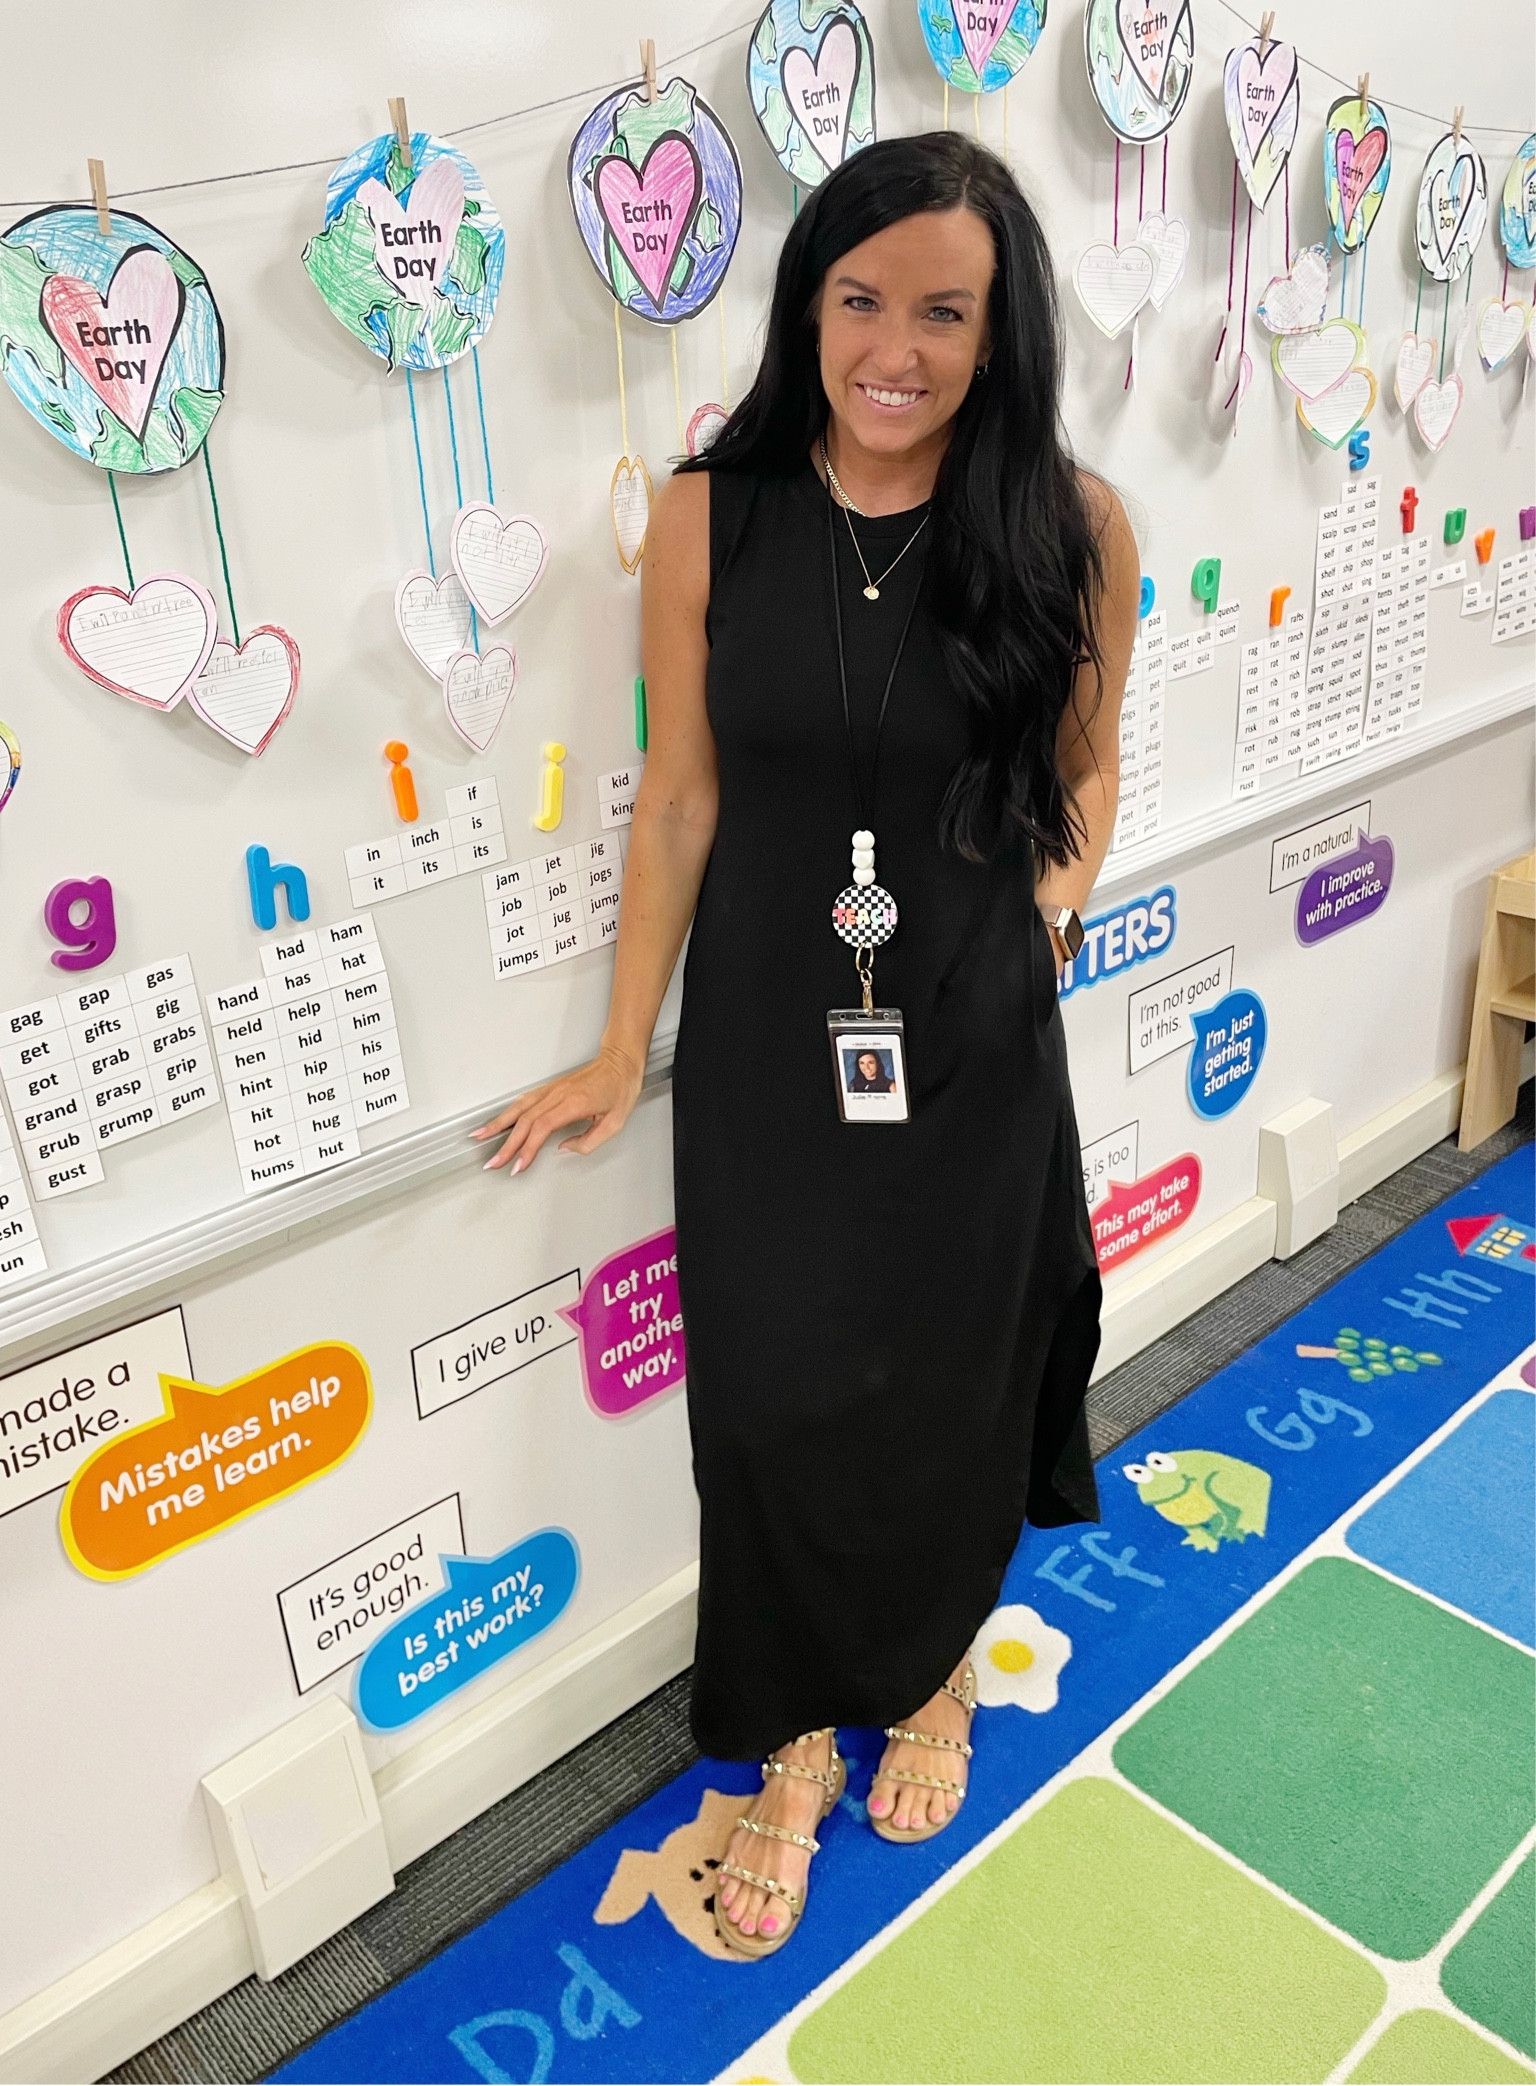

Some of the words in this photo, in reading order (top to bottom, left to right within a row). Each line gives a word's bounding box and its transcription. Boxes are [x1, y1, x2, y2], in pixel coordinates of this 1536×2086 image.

[967, 11, 998, 38] Day
[1133, 11, 1168, 39] Earth
[1140, 39, 1164, 62] Day
[801, 82, 841, 110] Earth
[1246, 82, 1275, 102] Earth
[812, 114, 839, 137] Day
[1248, 106, 1269, 127] Day
[1342, 160, 1364, 183] Earth
[1342, 182, 1357, 204] Day
[1438, 194, 1461, 212] Earth
[621, 199, 673, 224] Earth
[1440, 216, 1456, 230] Day
[380, 219, 442, 247] Earth
[632, 232, 668, 255] Day
[393, 256, 437, 281] Day
[75, 318, 152, 348] Earth
[94, 357, 147, 385] Day
[1348, 429, 1371, 471] s
[1399, 486, 1420, 534] t
[1190, 556, 1222, 615] q
[1268, 585, 1292, 628] r
[1246, 685, 1259, 695] rest
[1242, 763, 1255, 772] run
[384, 739, 420, 823] i
[533, 741, 568, 833] j
[611, 772, 630, 789] kid
[1239, 780, 1254, 791] rust
[467, 786, 477, 801] if
[471, 816, 483, 830] is
[411, 828, 440, 848] inch
[1281, 852, 1299, 871] I'm
[1302, 847, 1310, 862] a
[1312, 824, 1355, 858] natural.
[366, 848, 381, 862] in
[473, 845, 489, 859] its
[590, 842, 605, 859] jig
[422, 861, 439, 875] its
[545, 856, 562, 874] jet
[245, 842, 311, 932] h
[373, 877, 385, 890] it
[496, 872, 520, 891] jam
[589, 868, 612, 887] jogs
[1321, 879, 1326, 898] I
[1328, 861, 1375, 894] improve
[548, 882, 567, 902] job
[590, 893, 619, 914] jump
[1306, 899, 1332, 926] with
[1334, 879, 1383, 917] practice.
[501, 897, 522, 917] job
[832, 907, 899, 926] TEACH
[43, 874, 118, 973] g
[553, 910, 572, 928] jug
[601, 919, 617, 938] jut
[330, 924, 363, 943] ham
[506, 925, 525, 943] jot
[555, 935, 577, 955] just
[276, 939, 305, 961] had
[498, 950, 539, 973] jumps
[341, 953, 367, 971] hat
[146, 968, 174, 989] gas
[284, 973, 311, 990] has
[78, 989, 110, 1011] gap
[217, 986, 259, 1011] hand
[344, 983, 377, 1002] hem
[1140, 1003, 1159, 1024] I'm
[1163, 987, 1184, 1012] not
[1187, 967, 1221, 1005] good
[156, 999, 180, 1019] gig
[288, 1001, 321, 1021] help
[10, 1010, 43, 1033] gag
[84, 1019, 121, 1044] gifts
[227, 1018, 263, 1040] held
[352, 1012, 381, 1030] him
[1140, 1027, 1153, 1048] at
[1156, 1015, 1182, 1040] this.
[1206, 1028, 1226, 1051] I'm
[1227, 1010, 1254, 1043] just
[153, 1026, 196, 1053] grabs
[298, 1029, 322, 1049] hid
[361, 1040, 382, 1056] his
[20, 1042, 50, 1065] get
[92, 1048, 130, 1075] grab
[235, 1051, 266, 1068] hen
[1205, 1036, 1251, 1078] getting
[166, 1058, 197, 1081] grip
[303, 1060, 328, 1077] hip
[363, 1067, 390, 1085] hop
[28, 1073, 59, 1096] got
[95, 1079, 141, 1107] grasp
[240, 1077, 273, 1097] hint
[1204, 1066, 1253, 1097] started.
[171, 1087, 206, 1111] gum
[307, 1087, 336, 1105] hog
[365, 1093, 397, 1113] hum
[25, 1098, 78, 1131] grand
[98, 1108, 153, 1139] grump
[251, 1107, 274, 1123] hit
[312, 1115, 341, 1132] hug
[38, 1132, 80, 1159] grub
[253, 1134, 281, 1152] hot
[318, 1141, 344, 1159] hut
[250, 1160, 295, 1181] hums
[1094, 1159, 1105, 1177] is
[1107, 1146, 1130, 1169] too
[48, 1163, 87, 1188] gust
[1094, 1214, 1124, 1241] This
[1127, 1194, 1158, 1223] may
[1160, 1175, 1189, 1202] take
[1099, 1229, 1139, 1261] some
[1142, 1199, 1182, 1236] effort.
[602, 1268, 640, 1307] Let
[1381, 1267, 1503, 1331] Hh
[629, 1293, 662, 1323] try
[439, 1359, 445, 1383] I
[455, 1336, 506, 1382] give
[515, 1316, 552, 1344] up.
[600, 1314, 683, 1369] anothe
[107, 1361, 130, 1387] a
[622, 1348, 677, 1389] way.
[1244, 1387, 1374, 1452] Gg
[101, 1417, 261, 1511] Mistakes
[270, 1376, 340, 1426] help
[147, 1484, 205, 1525] me
[214, 1432, 311, 1491] learn.
[309, 1588, 345, 1621] It's
[352, 1533, 423, 1595] good
[1033, 1529, 1167, 1615] Ff
[317, 1573, 429, 1651] enough.
[404, 1633, 428, 1659] Is
[434, 1597, 484, 1639] this
[492, 1565, 530, 1603] my
[398, 1641, 459, 1696] best
[466, 1584, 543, 1649] work?
[446, 1940, 644, 2086] Dd
